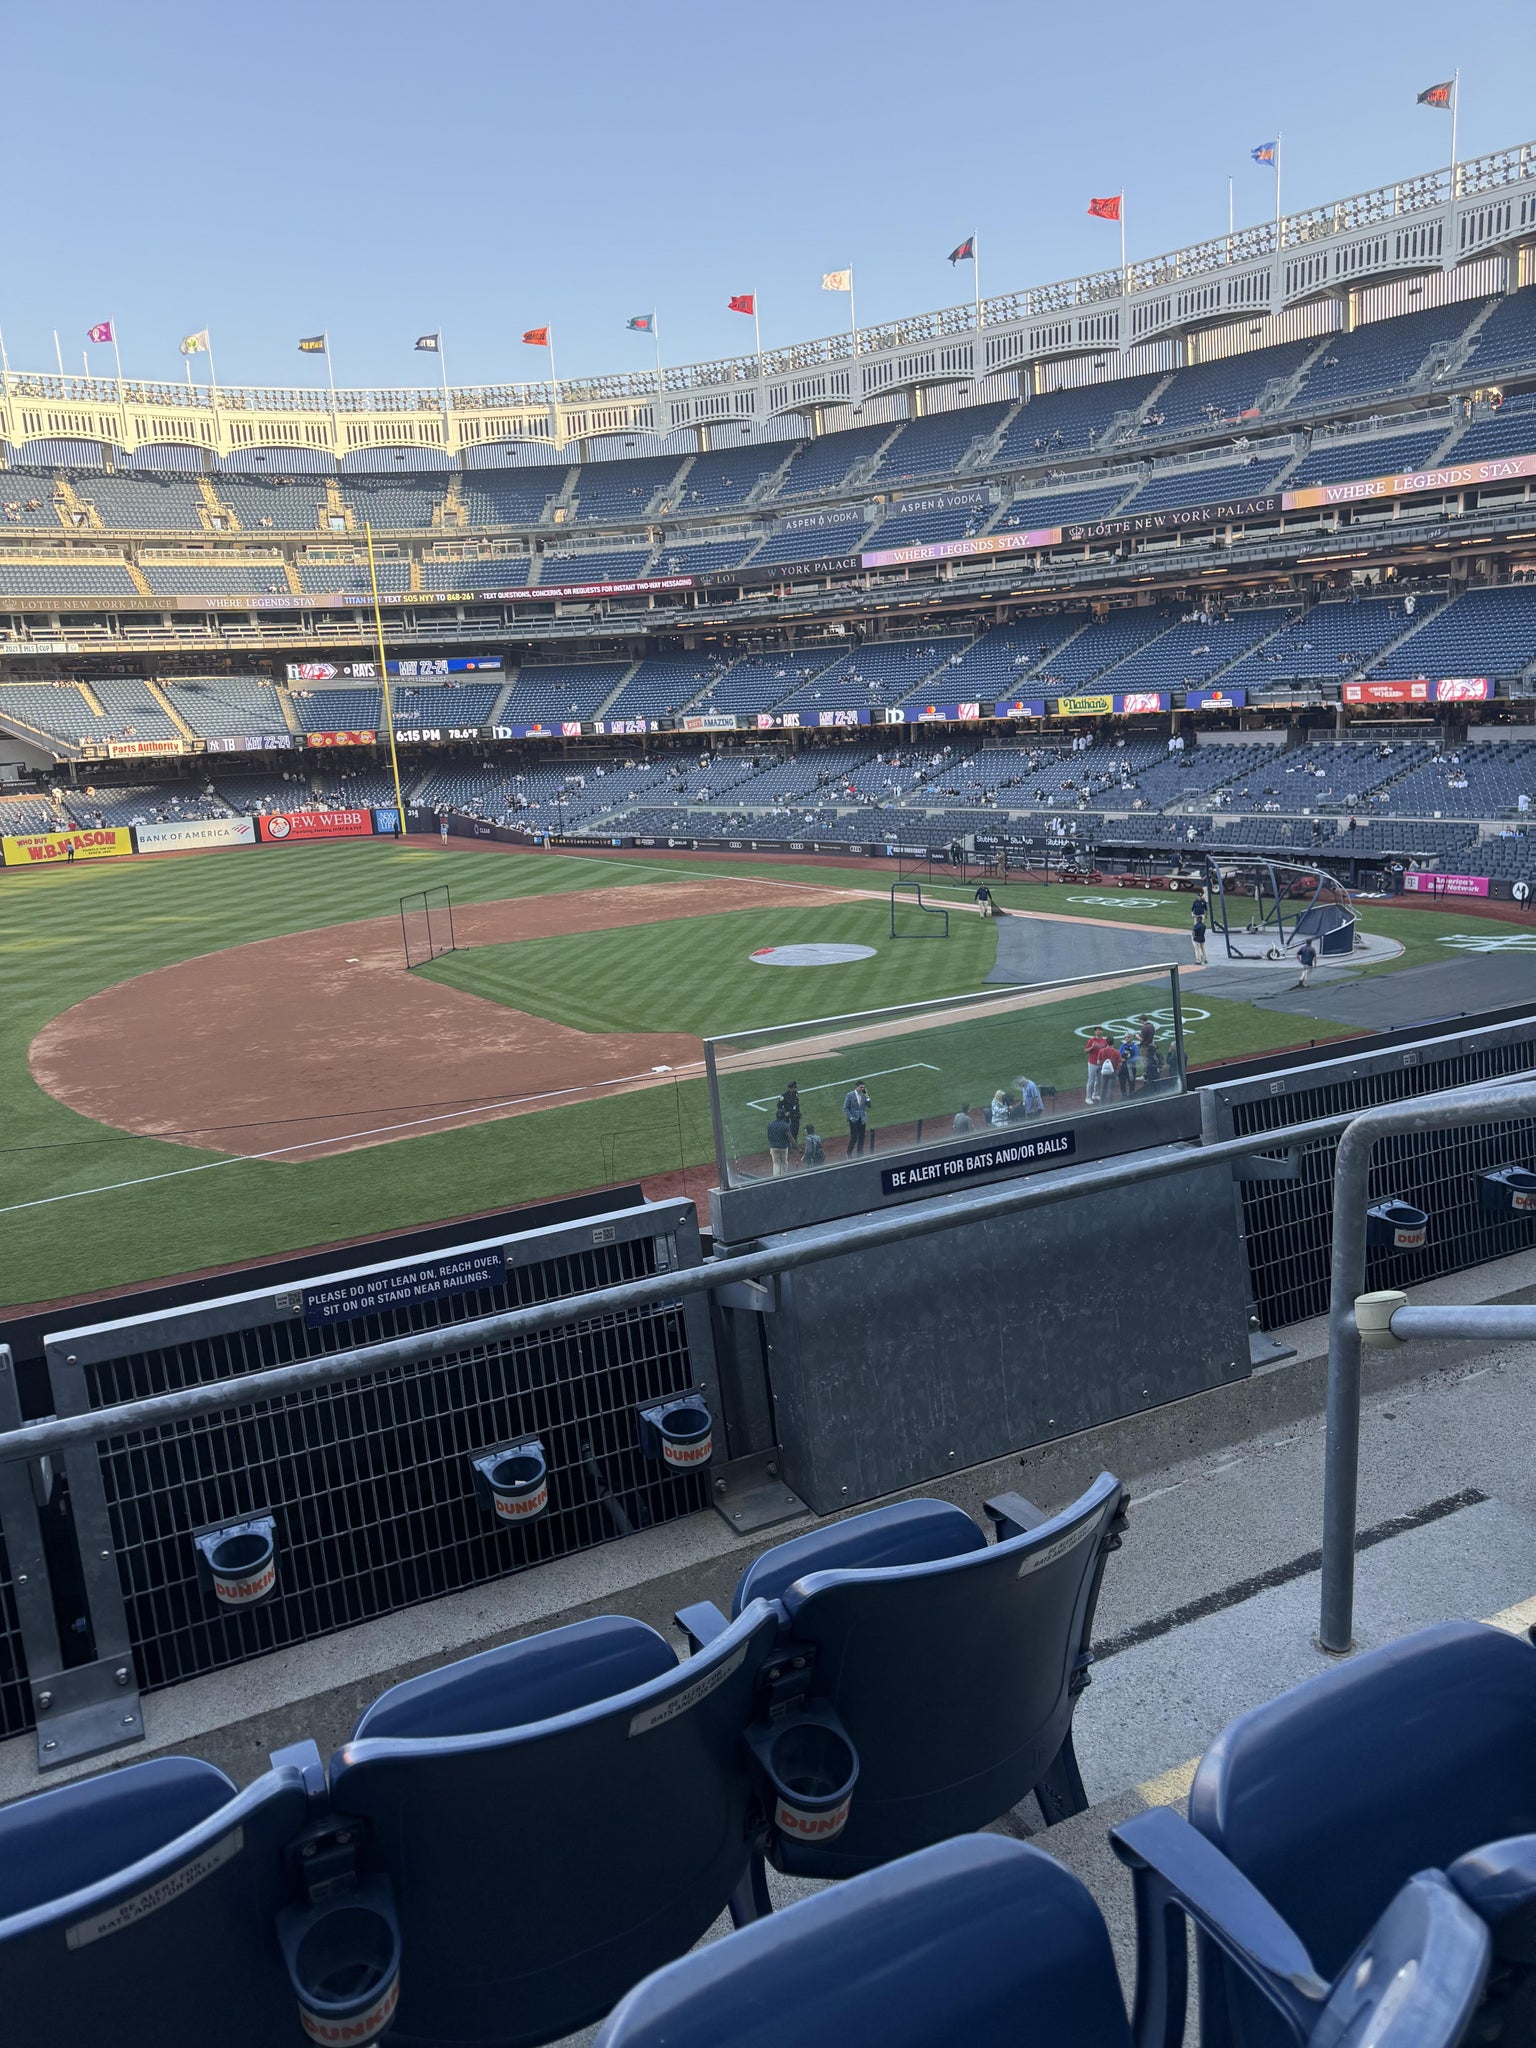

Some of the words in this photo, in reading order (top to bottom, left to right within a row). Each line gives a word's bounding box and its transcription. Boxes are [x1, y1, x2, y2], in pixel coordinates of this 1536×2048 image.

[1327, 481, 1386, 501] WHERE
[1393, 469, 1472, 491] LEGENDS
[1480, 460, 1526, 479] STAY.
[901, 501, 934, 513] ASPEN
[947, 493, 982, 507] VODKA
[786, 517, 816, 530] ASPEN
[827, 512, 859, 524] VODKA
[1088, 521, 1130, 537] LOTTE
[1135, 516, 1166, 530] NEW
[1172, 509, 1211, 524] YORK
[1217, 500, 1274, 517] PALACE
[893, 547, 935, 561] WHERE
[940, 541, 994, 556] LEGENDS
[999, 535, 1030, 548] STAY.
[781, 564, 810, 576] YORK
[814, 558, 857, 572] PALACE
[344, 596, 366, 604] TITAN
[367, 596, 383, 604] HT
[403, 595, 418, 603] SOS
[419, 594, 435, 602] NYY
[436, 594, 446, 602] TO
[447, 593, 475, 601] 848-261
[498, 591, 532, 599] QUESTIONS,
[532, 589, 563, 597] CONCERNS,
[573, 586, 601, 594] REQUESTS
[614, 583, 636, 592] INSTANT
[637, 581, 661, 590] TWO-WAY
[662, 579, 692, 588] MESSAGING
[21, 600, 60, 609] LOTTE
[64, 600, 90, 609] NEW
[95, 600, 127, 609] YORK
[131, 599, 173, 608] PALACE
[206, 599, 242, 607] WHERE
[246, 598, 291, 607] LEGENDS
[293, 598, 319, 606] STAY.
[352, 663, 375, 677] RAYS
[420, 660, 448, 675] 22-24
[1063, 697, 1108, 710] Nathan's
[704, 719, 734, 727] AMAZING
[783, 713, 800, 727] RAYS
[396, 730, 420, 742] 6:15
[423, 730, 441, 741] PM
[449, 729, 478, 739] 78.6°F
[112, 745, 137, 754] Parts
[223, 739, 235, 751] TB
[264, 735, 291, 750] 22-24
[292, 815, 317, 828] F.W.
[320, 812, 362, 826] WEBB
[17, 838, 33, 847] WHO
[34, 837, 47, 845] BUT
[140, 833, 167, 843] BANK
[170, 831, 183, 840] OF
[184, 829, 229, 839] AMERICA
[976, 835, 998, 844] StubHub
[1447, 884, 1479, 893] Network
[892, 1172, 907, 1187] BE
[908, 1163, 941, 1183] ALERT
[944, 1158, 964, 1176] FOR
[966, 1153, 993, 1170] BATS
[995, 1144, 1035, 1164] AND/OR
[1037, 1137, 1068, 1158] BALLS
[308, 1289, 348, 1306] PLEASE
[350, 1285, 364, 1297] DO
[367, 1279, 388, 1293] NOT
[391, 1273, 417, 1287] LEAN
[420, 1269, 437, 1281] ON,
[439, 1261, 472, 1277] REACH
[474, 1255, 502, 1269] OVER,
[323, 1304, 340, 1316] SIT
[343, 1300, 358, 1312] ON
[361, 1296, 375, 1308] OR
[377, 1288, 411, 1304] STAND
[414, 1281, 440, 1296] NEAR
[443, 1270, 491, 1289] RAILINGS.
[664, 1441, 712, 1462] DUNKIN
[496, 1488, 547, 1514] DUNKIN
[216, 1567, 275, 1598] DUNKIN
[650, 1709, 673, 1724] BATS
[140, 1880, 175, 1905] ALERT
[180, 1863, 201, 1879] FOR
